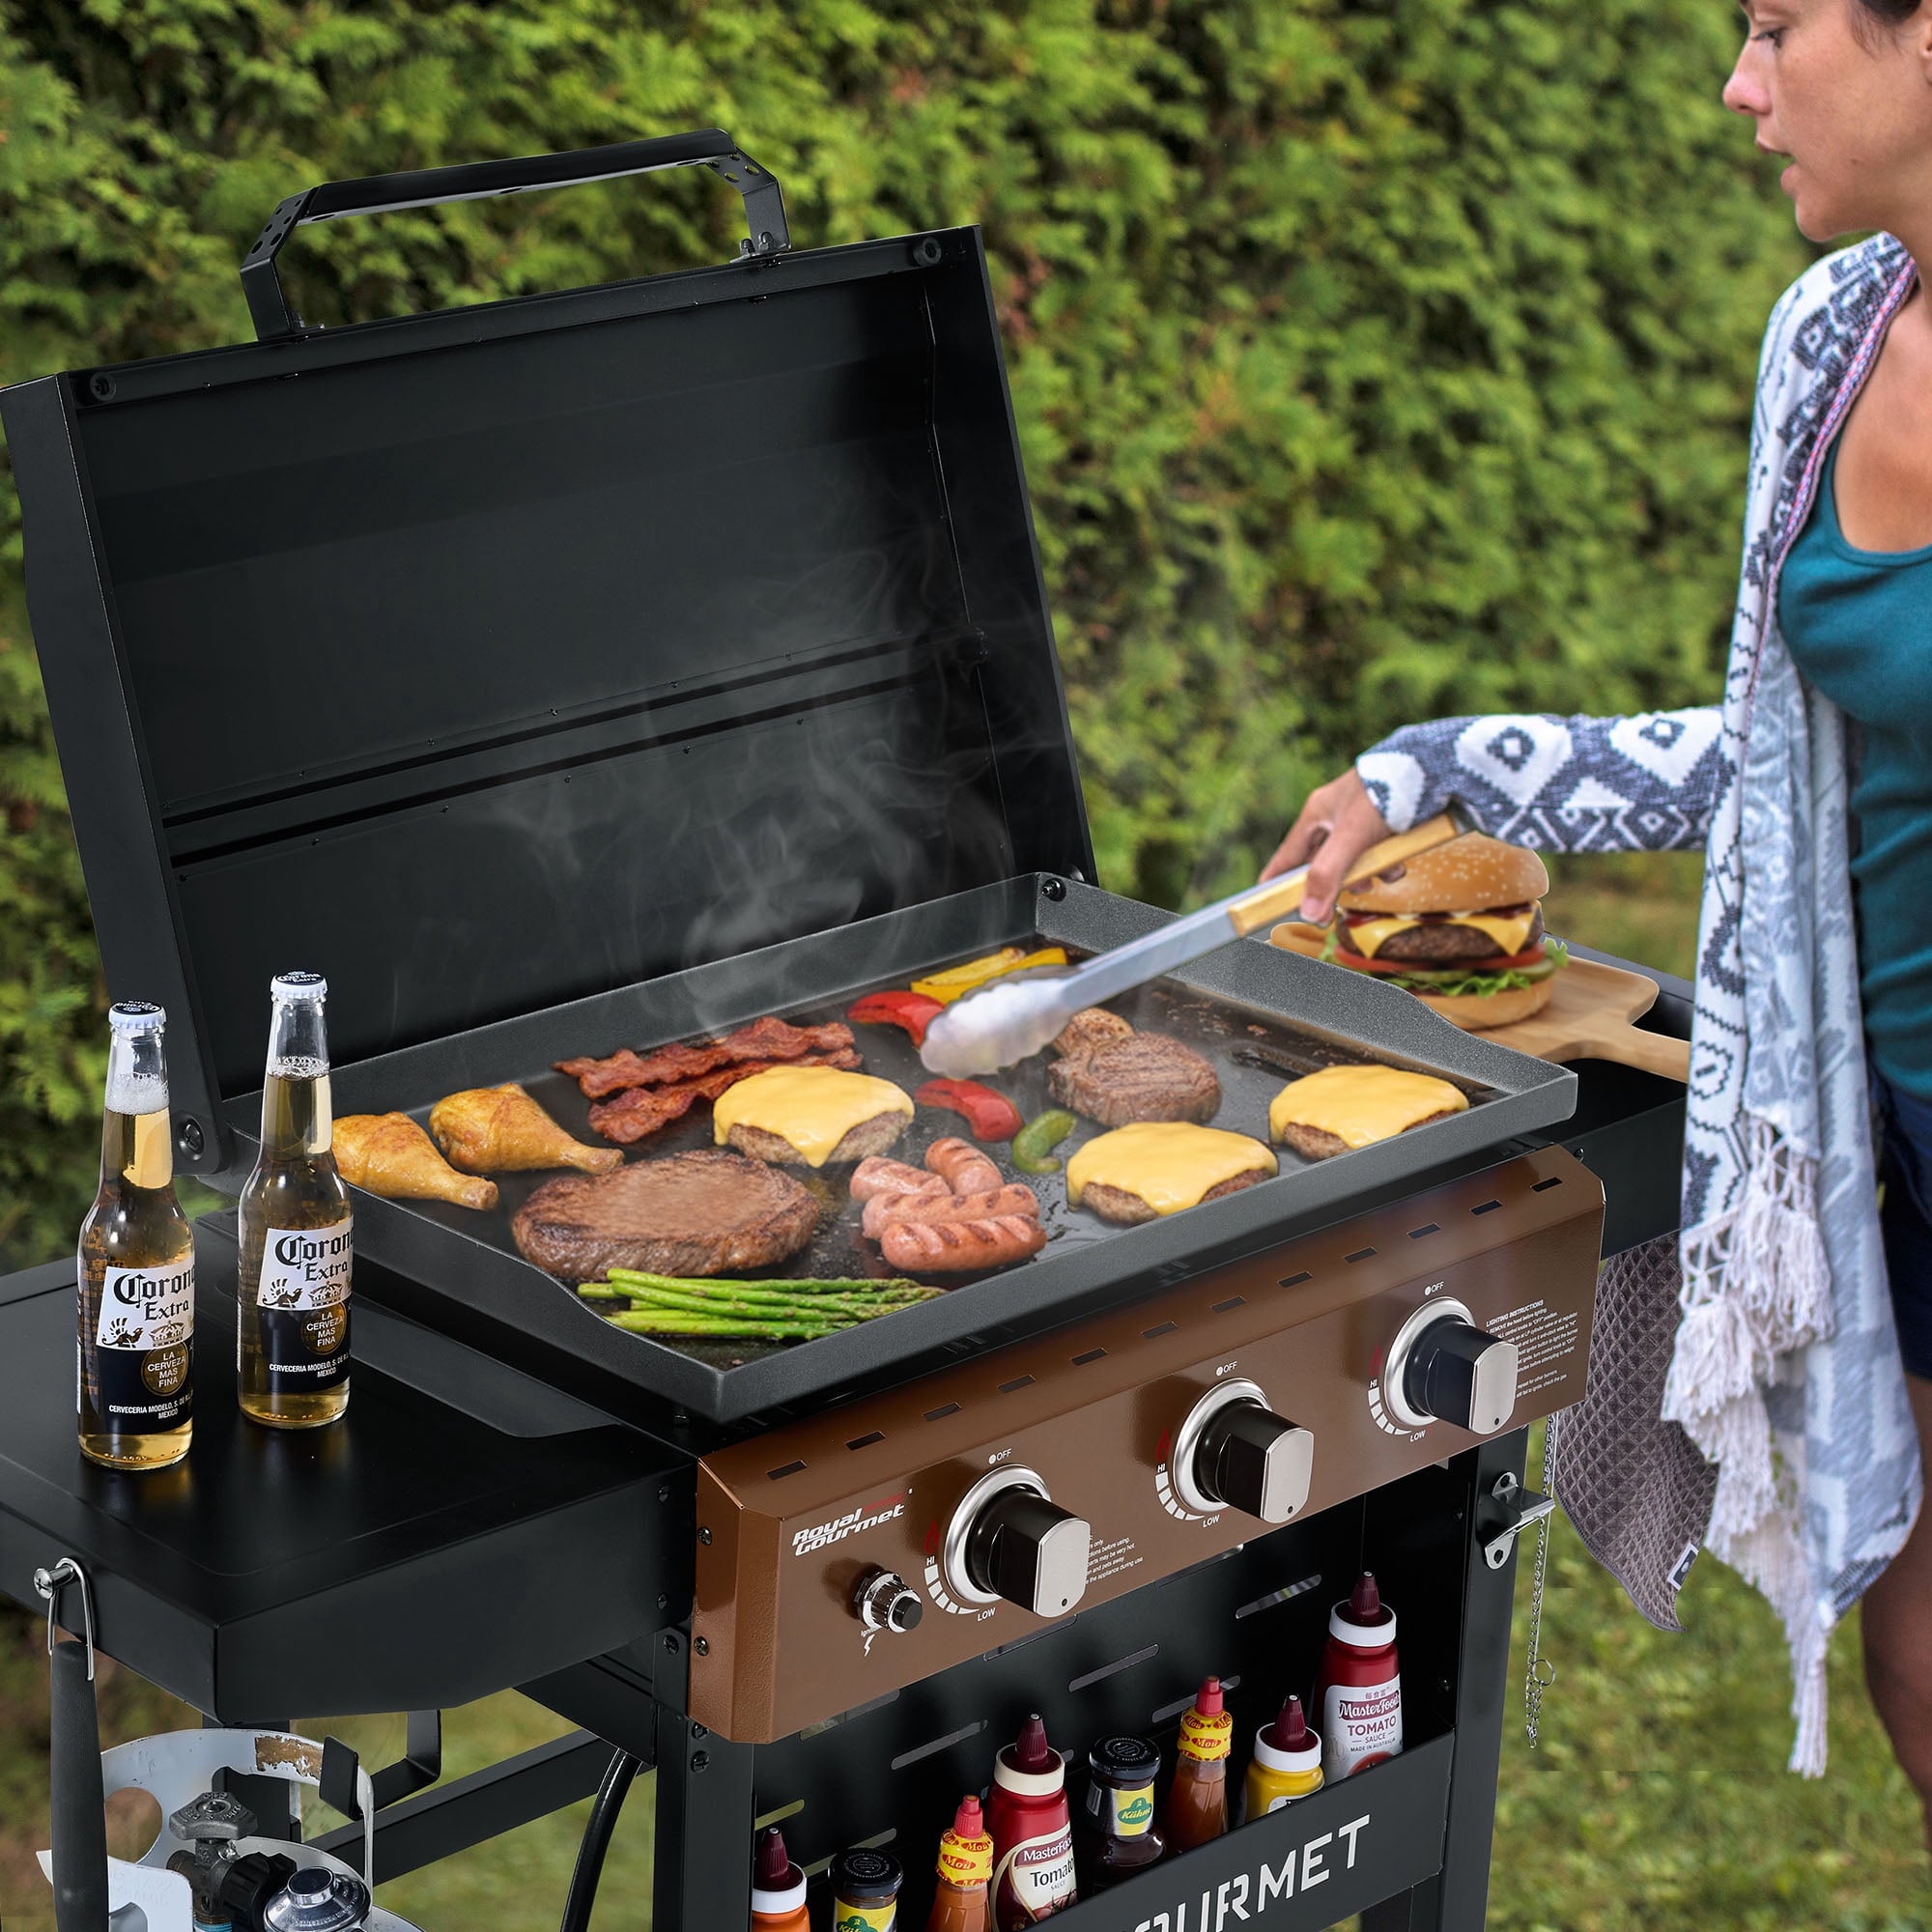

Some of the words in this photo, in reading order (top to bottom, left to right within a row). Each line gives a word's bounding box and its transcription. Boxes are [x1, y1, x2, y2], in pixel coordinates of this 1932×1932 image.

[304, 1261, 348, 1282] Extra
[1431, 1281, 1444, 1293] OFF
[144, 1299, 189, 1321] Extra
[321, 1311, 333, 1321] LA
[1486, 1313, 1509, 1327] LIGHTING
[1509, 1299, 1545, 1318] INSTRUCTIONS
[306, 1316, 344, 1331] CERVEZA
[317, 1326, 336, 1339] MAS
[317, 1336, 336, 1348] FINA
[162, 1351, 175, 1360] LA
[147, 1355, 186, 1372] CERVEZA
[269, 1363, 307, 1373] CERVECERIA
[1223, 1360, 1237, 1373] OFF
[158, 1367, 179, 1379] MAS
[317, 1366, 337, 1378] MEXICO
[158, 1376, 179, 1388] FINA
[1370, 1378, 1378, 1388] HI
[108, 1405, 148, 1414] CERVECERIA
[157, 1407, 179, 1419] MEXICO
[1409, 1430, 1426, 1442] LOW
[996, 1448, 1011, 1461] OFF
[1157, 1463, 1166, 1473] HI
[792, 1507, 863, 1546] Royal
[1203, 1514, 1220, 1527] LOW
[795, 1503, 905, 1556] Gourmet
[926, 1555, 935, 1566] HI
[977, 1606, 996, 1621] LOW
[1347, 1715, 1397, 1737] TOMATO
[1364, 1732, 1386, 1744] SAUCE
